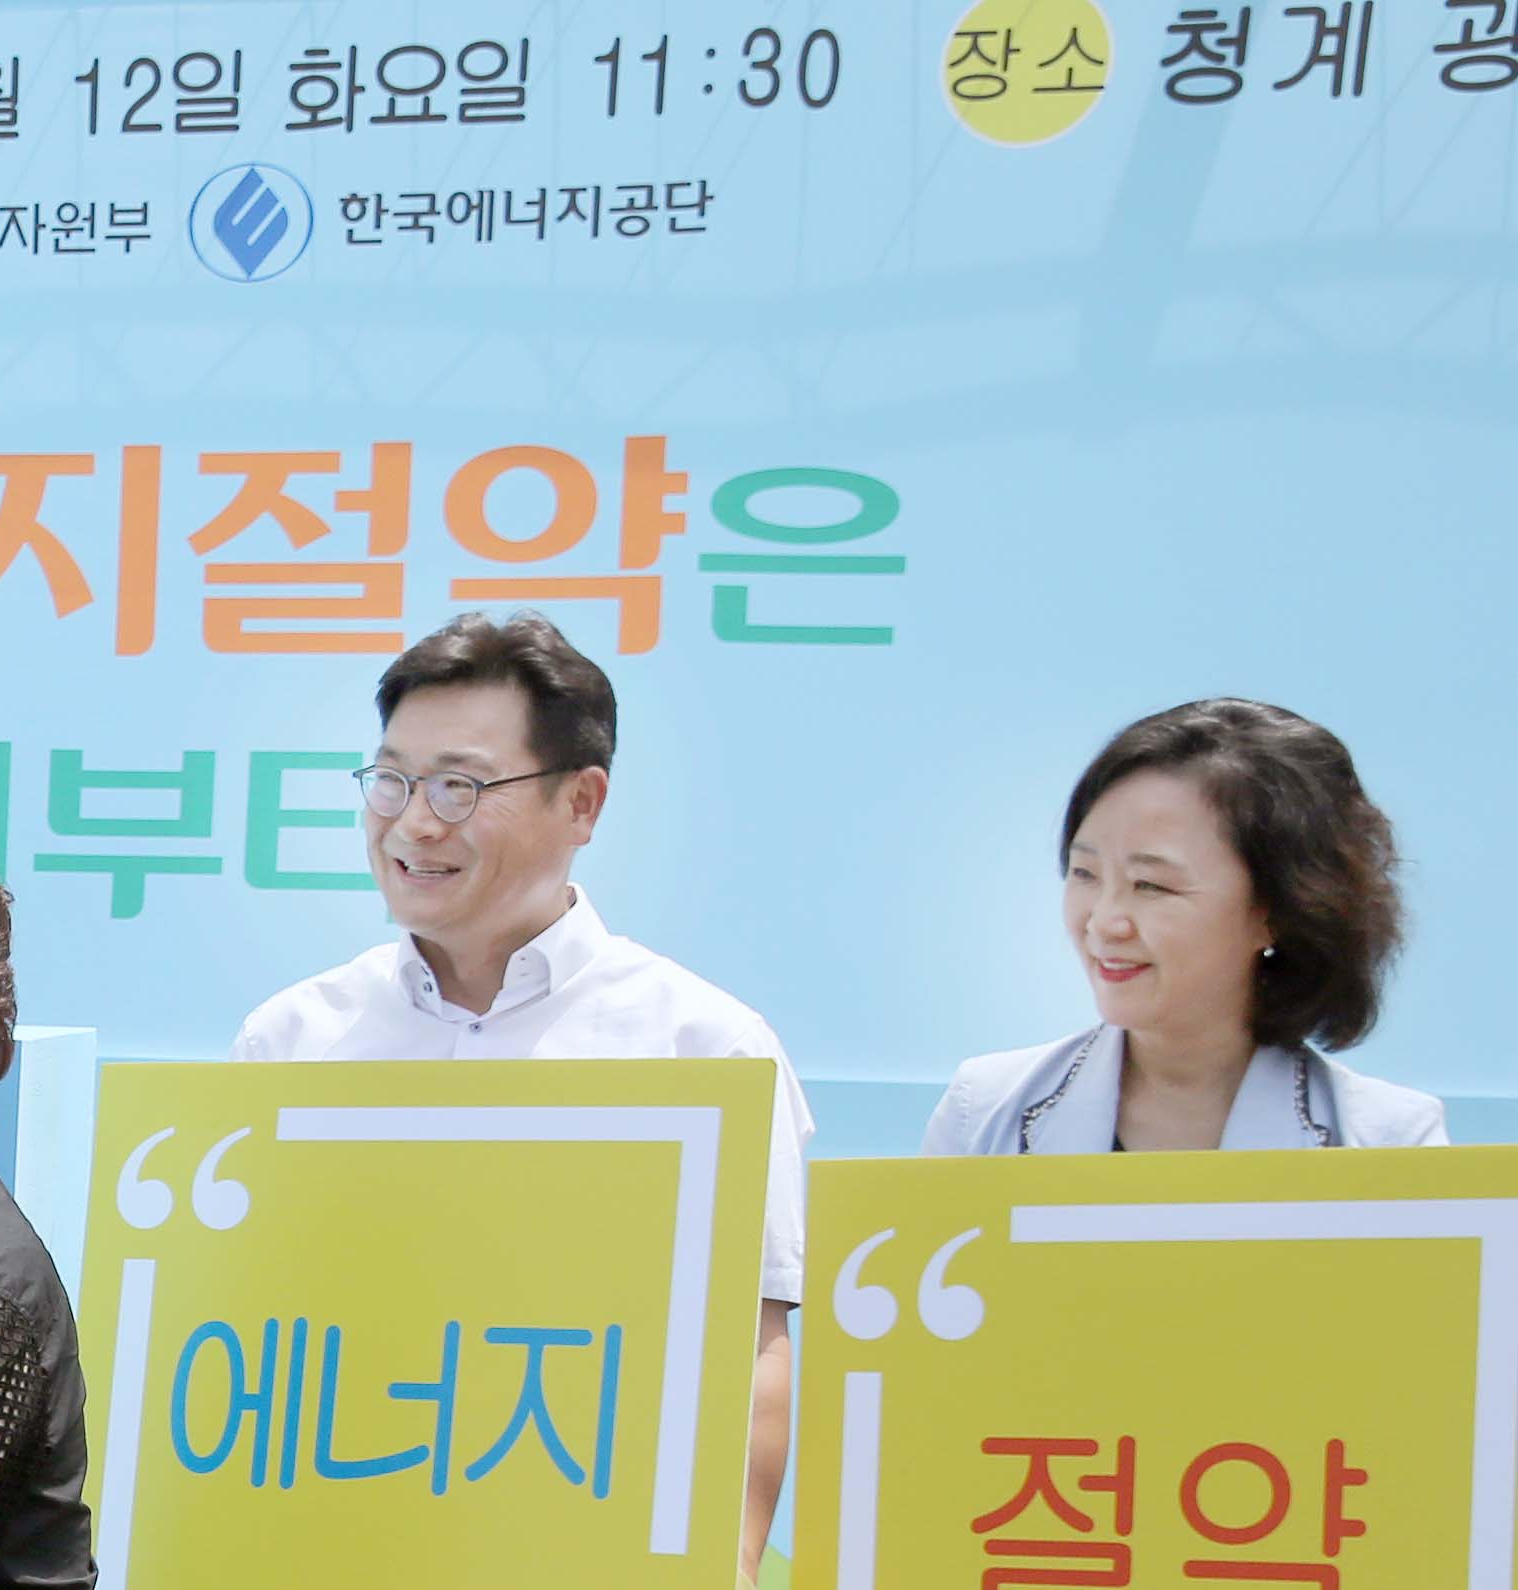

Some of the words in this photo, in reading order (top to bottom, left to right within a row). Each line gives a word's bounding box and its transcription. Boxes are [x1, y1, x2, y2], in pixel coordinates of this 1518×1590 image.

[74, 48, 243, 136] 12일
[284, 36, 530, 134] 화요일
[593, 26, 841, 118] 11:30
[948, 25, 1106, 102] 장소
[1159, 0, 1375, 105] 청계
[339, 179, 715, 245] 한국에너지공단
[170, 1317, 623, 1500] 에너지
